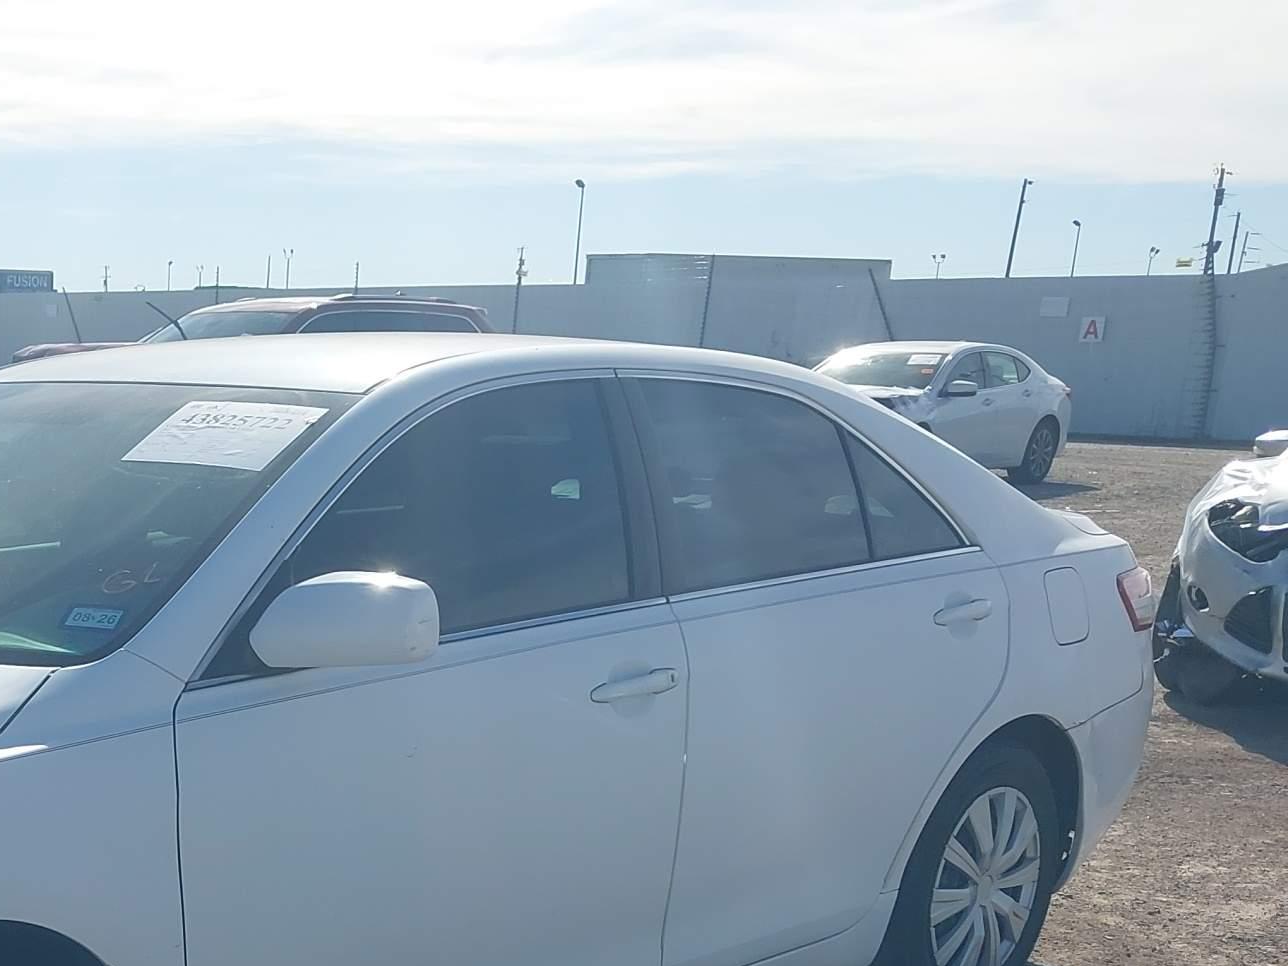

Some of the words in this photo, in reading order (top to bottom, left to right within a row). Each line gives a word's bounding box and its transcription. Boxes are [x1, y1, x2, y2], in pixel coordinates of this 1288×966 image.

[7, 274, 48, 288] FUSION
[1083, 319, 1098, 339] A
[181, 412, 293, 430] 43825722
